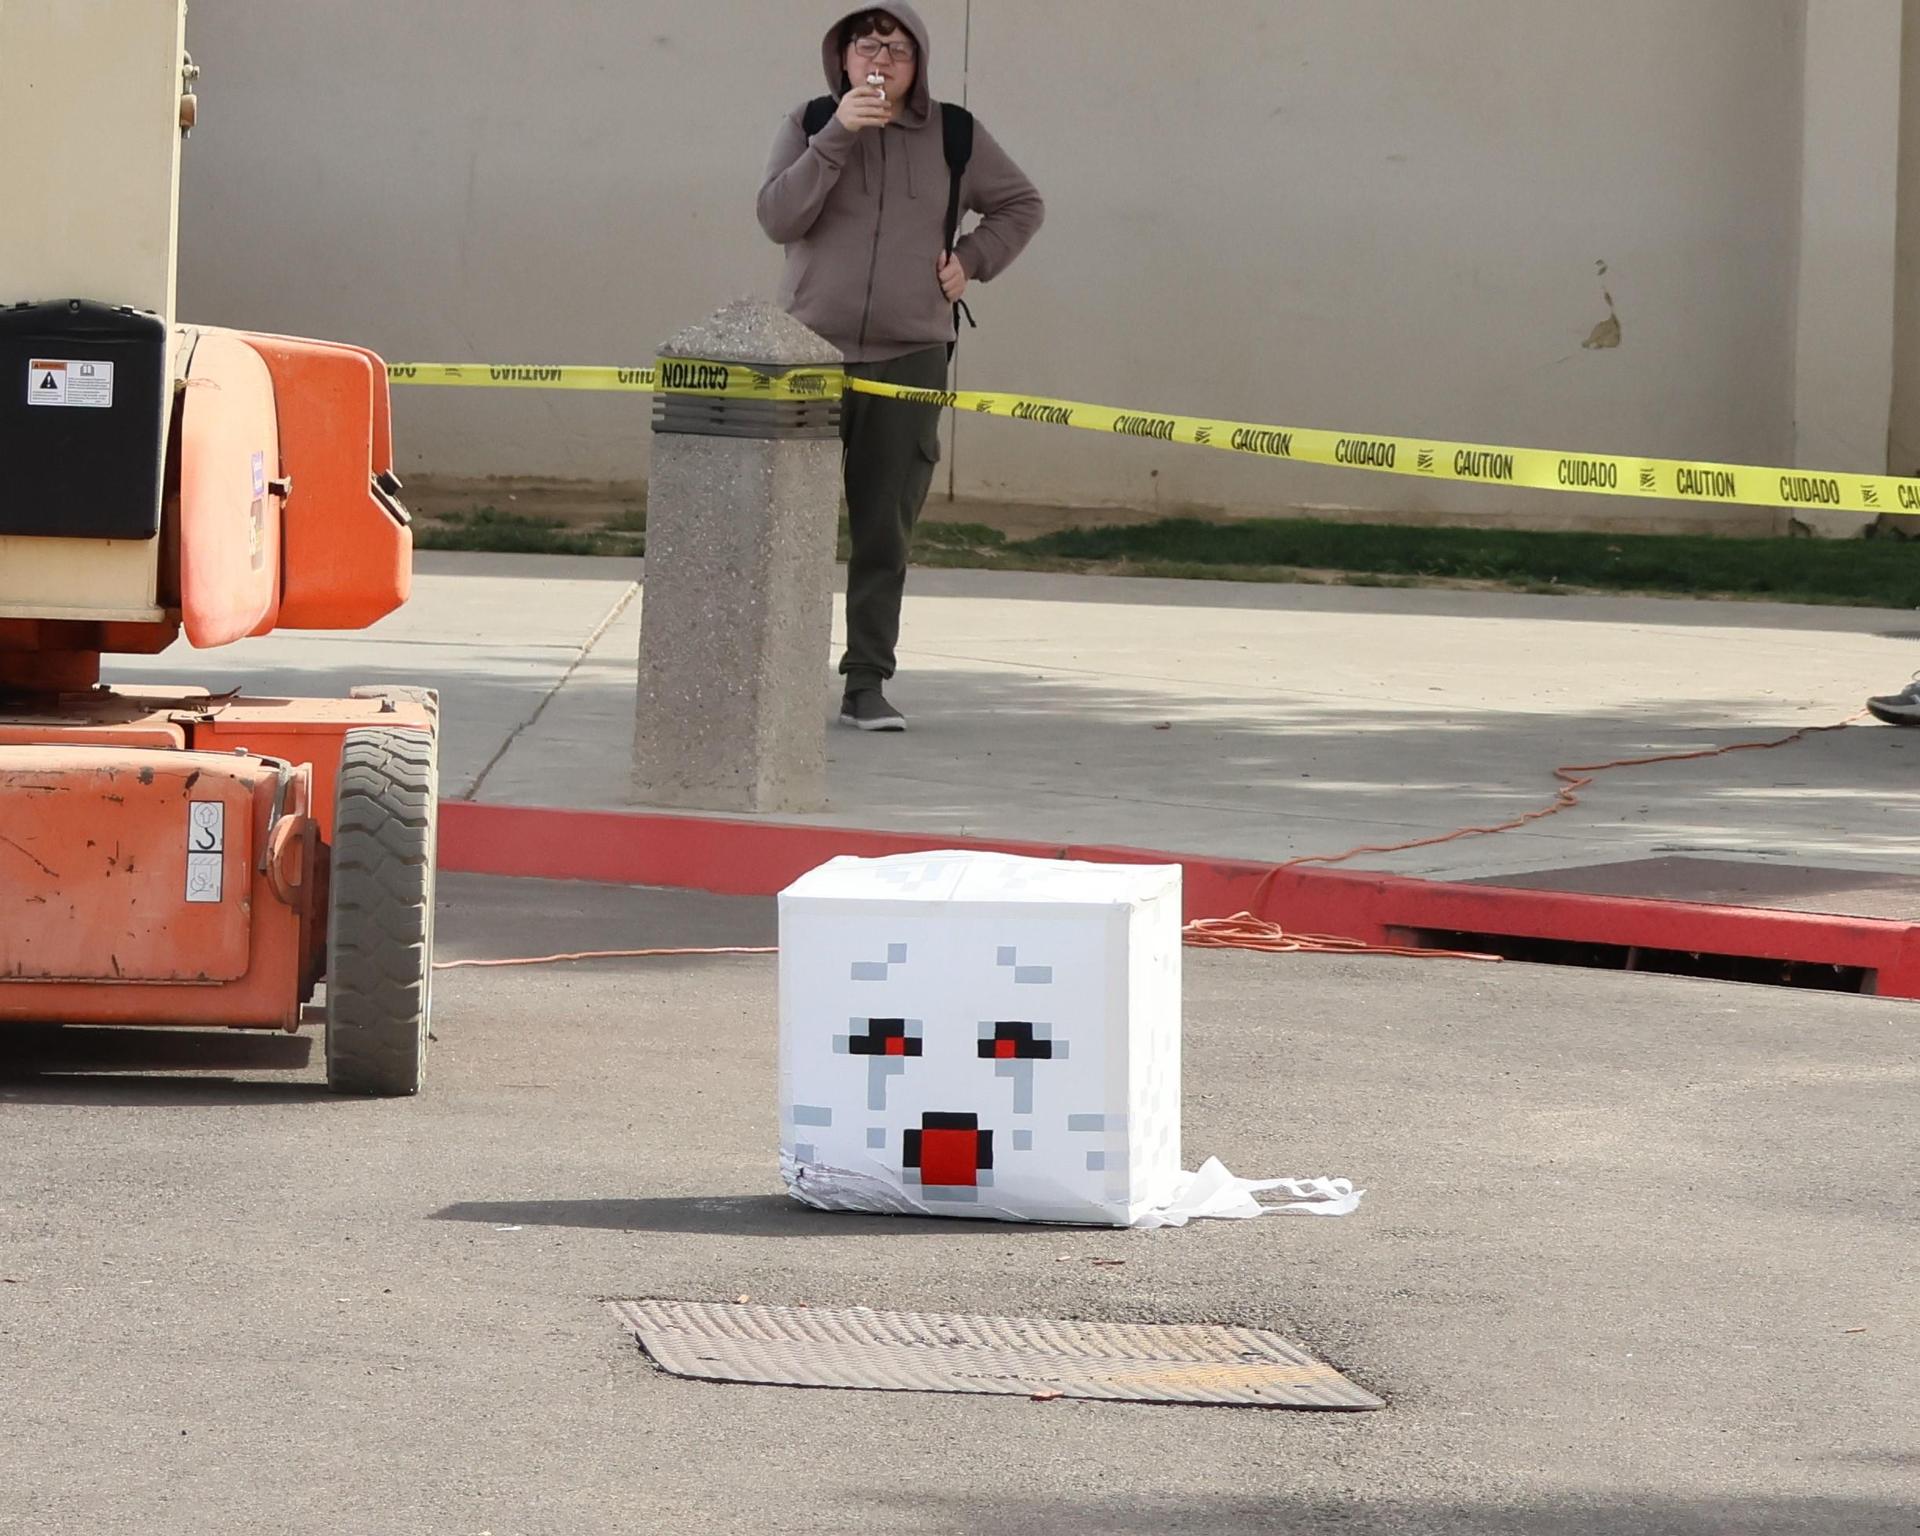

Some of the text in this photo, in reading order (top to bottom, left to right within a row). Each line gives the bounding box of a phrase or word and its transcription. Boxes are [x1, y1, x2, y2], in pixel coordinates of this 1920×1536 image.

[662, 362, 729, 390] CAUTION
[1011, 401, 1074, 426] CAUTION
[1113, 415, 1175, 441] CUIDADO
[1231, 428, 1293, 456] CAUTION
[1335, 439, 1396, 468] CUIDADO
[1454, 449, 1514, 481] CAUTION
[1558, 459, 1618, 489] CUIDADO
[1676, 468, 1737, 498] CAUTION
[1779, 476, 1841, 505] CUIDADO
